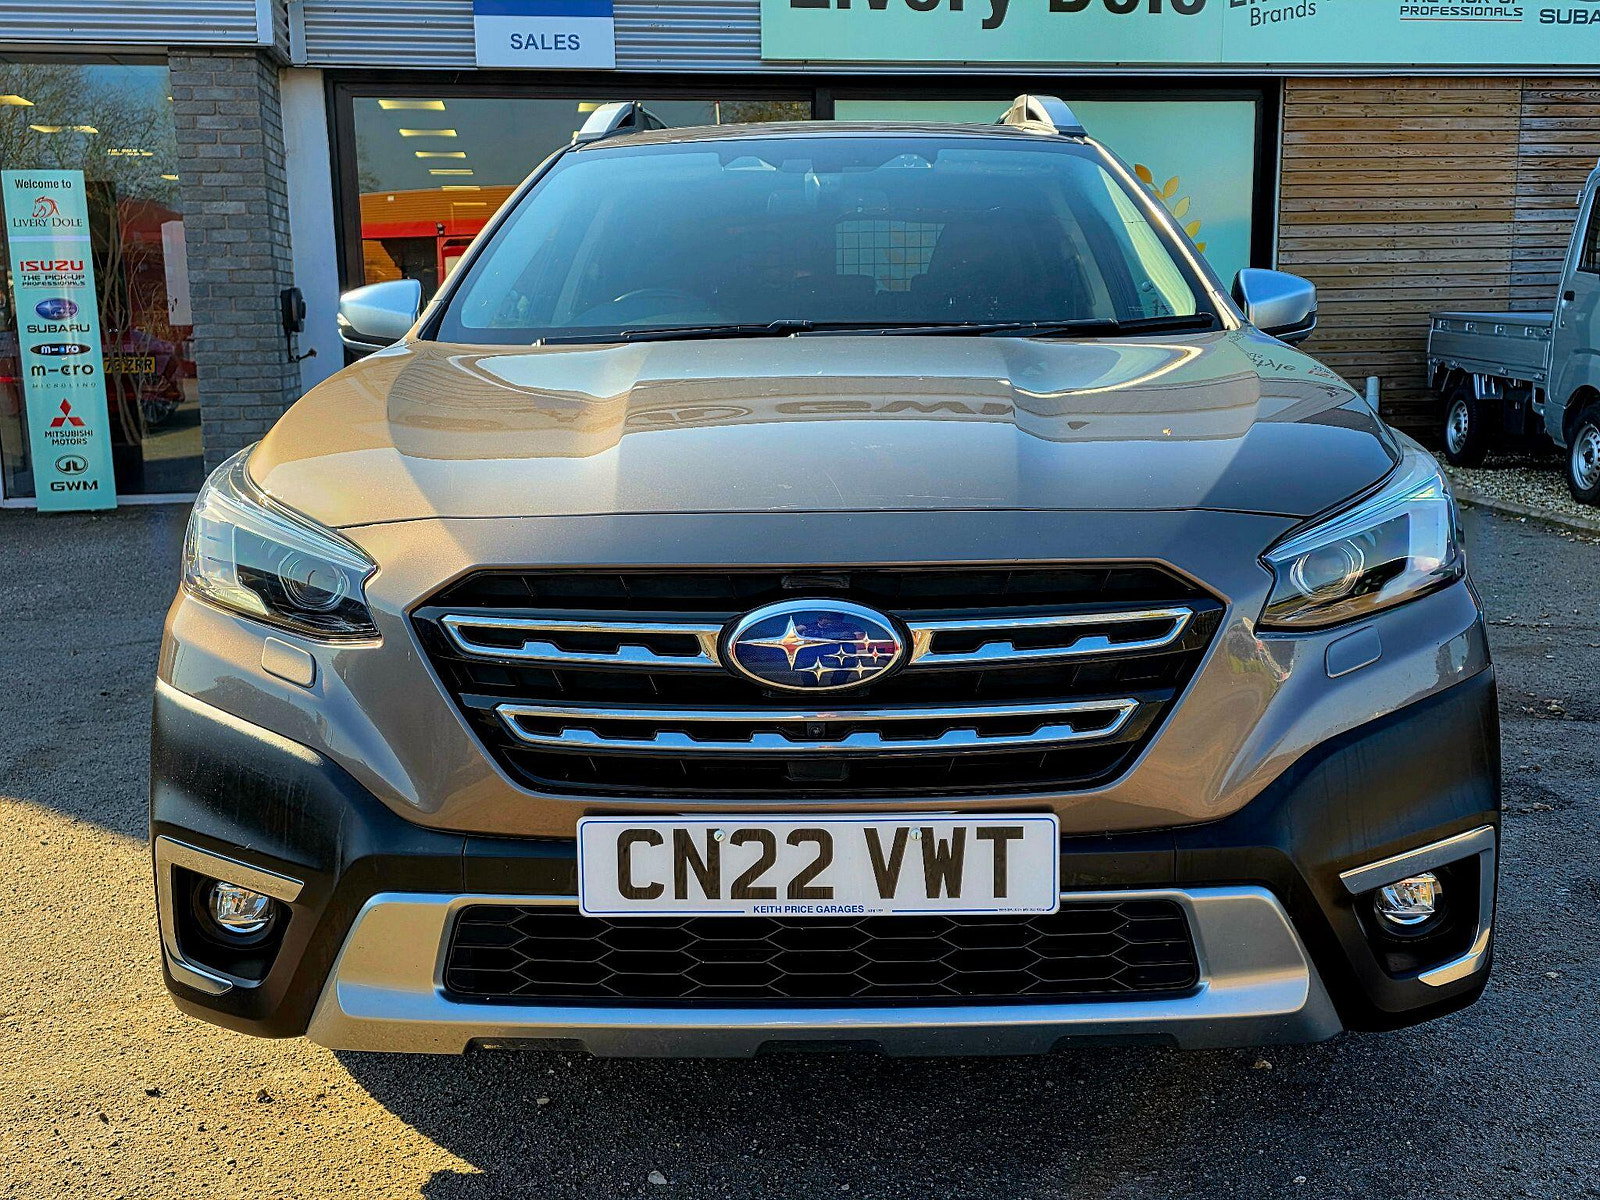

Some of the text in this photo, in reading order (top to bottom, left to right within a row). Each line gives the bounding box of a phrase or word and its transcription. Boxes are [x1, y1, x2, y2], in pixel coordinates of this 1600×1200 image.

[1250, 0, 1316, 27] Brands
[1399, 6, 1523, 17] PROFESSIONALS
[510, 33, 581, 51] SALES
[14, 178, 72, 189] Welcome to
[13, 218, 83, 228] LIVERY DOLE
[20, 260, 84, 272] ISUZU
[27, 324, 90, 334] SUBARU
[44, 429, 93, 438] MITSUBISHI
[52, 437, 88, 446] MOTORS
[50, 480, 99, 492] GWM
[616, 826, 1025, 901] CN22 VWT
[753, 905, 782, 914] KEITH
[784, 905, 814, 914] PRICE
[815, 905, 865, 914] GARAGES
